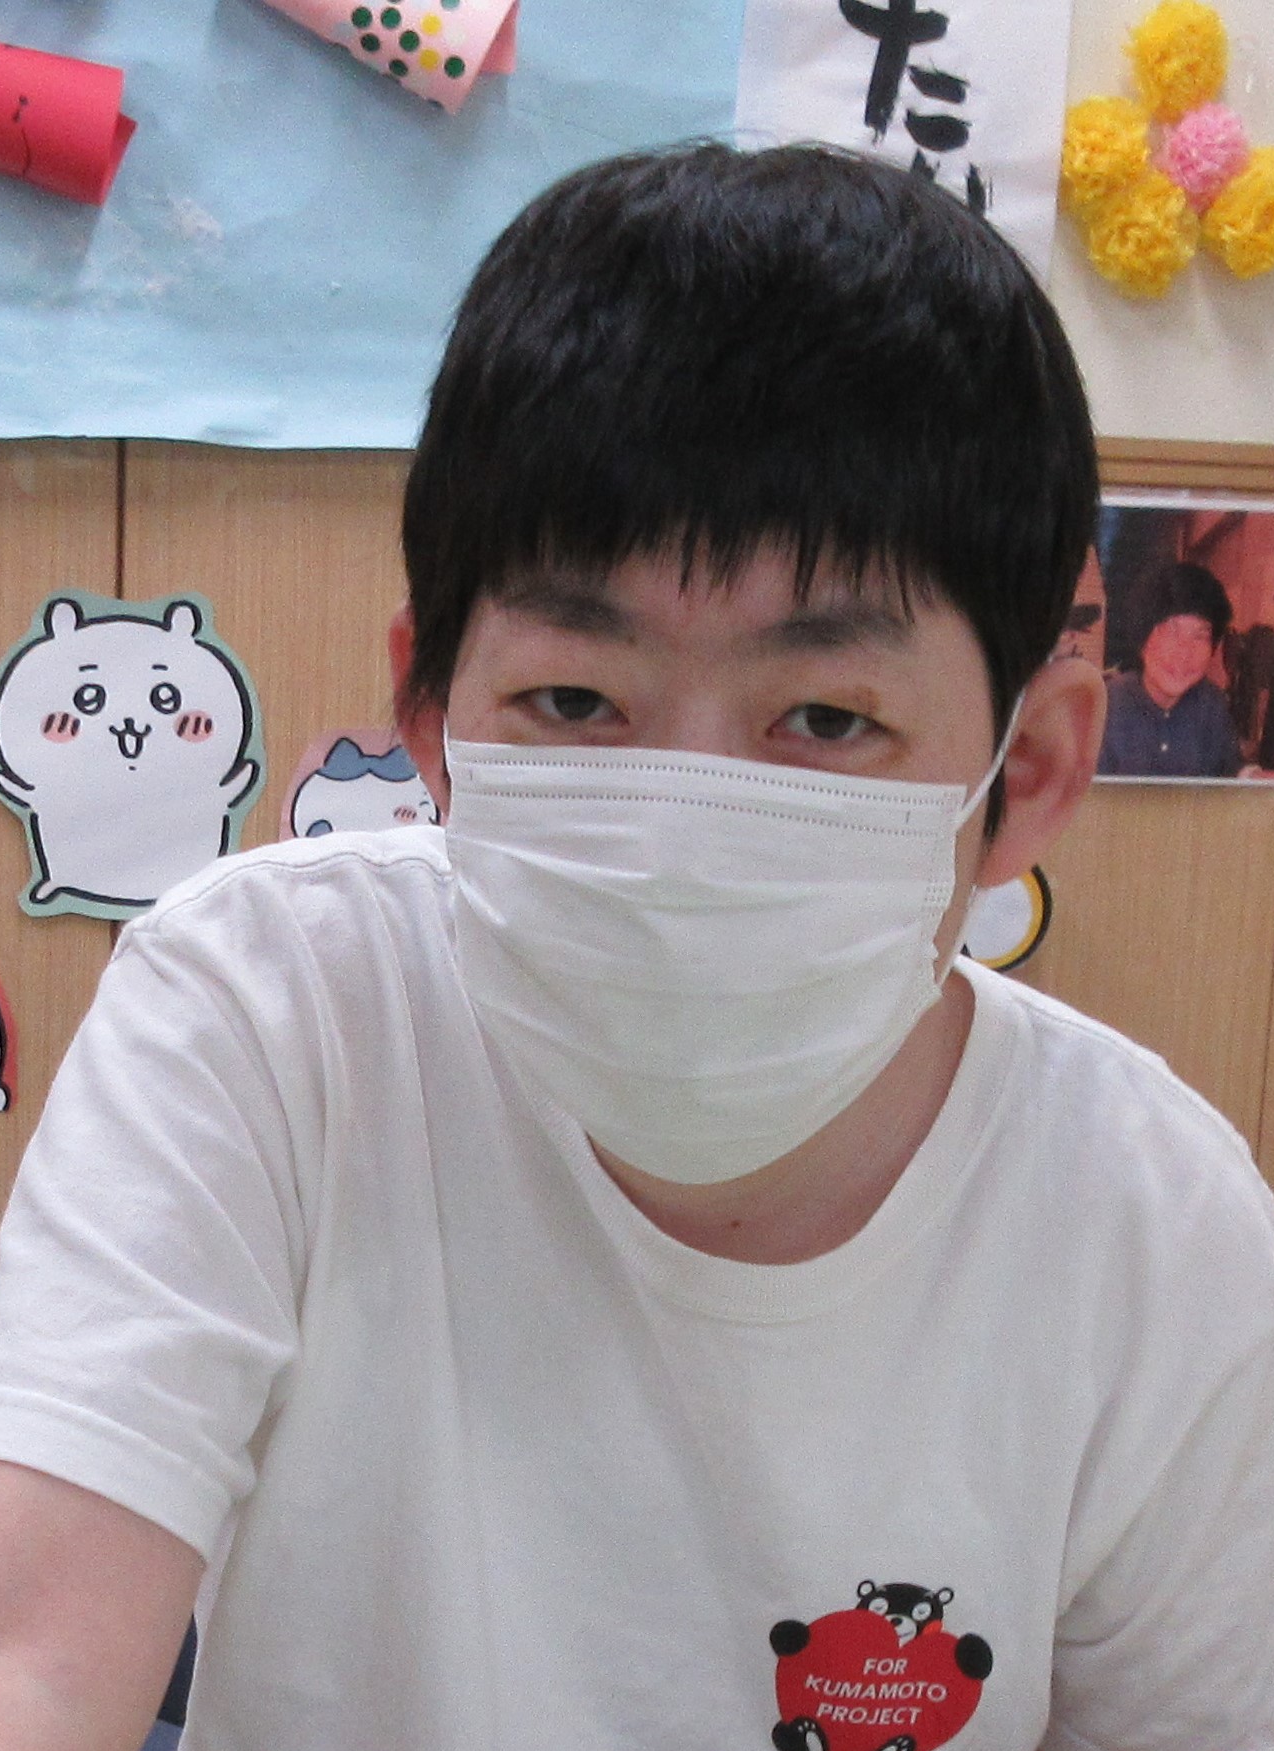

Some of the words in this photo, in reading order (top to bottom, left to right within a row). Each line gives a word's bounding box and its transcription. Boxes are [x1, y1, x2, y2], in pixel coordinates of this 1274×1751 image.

[862, 1658, 909, 1676] FOR
[804, 1674, 948, 1702] KUMAMOTO
[816, 1702, 923, 1725] PROJECT
